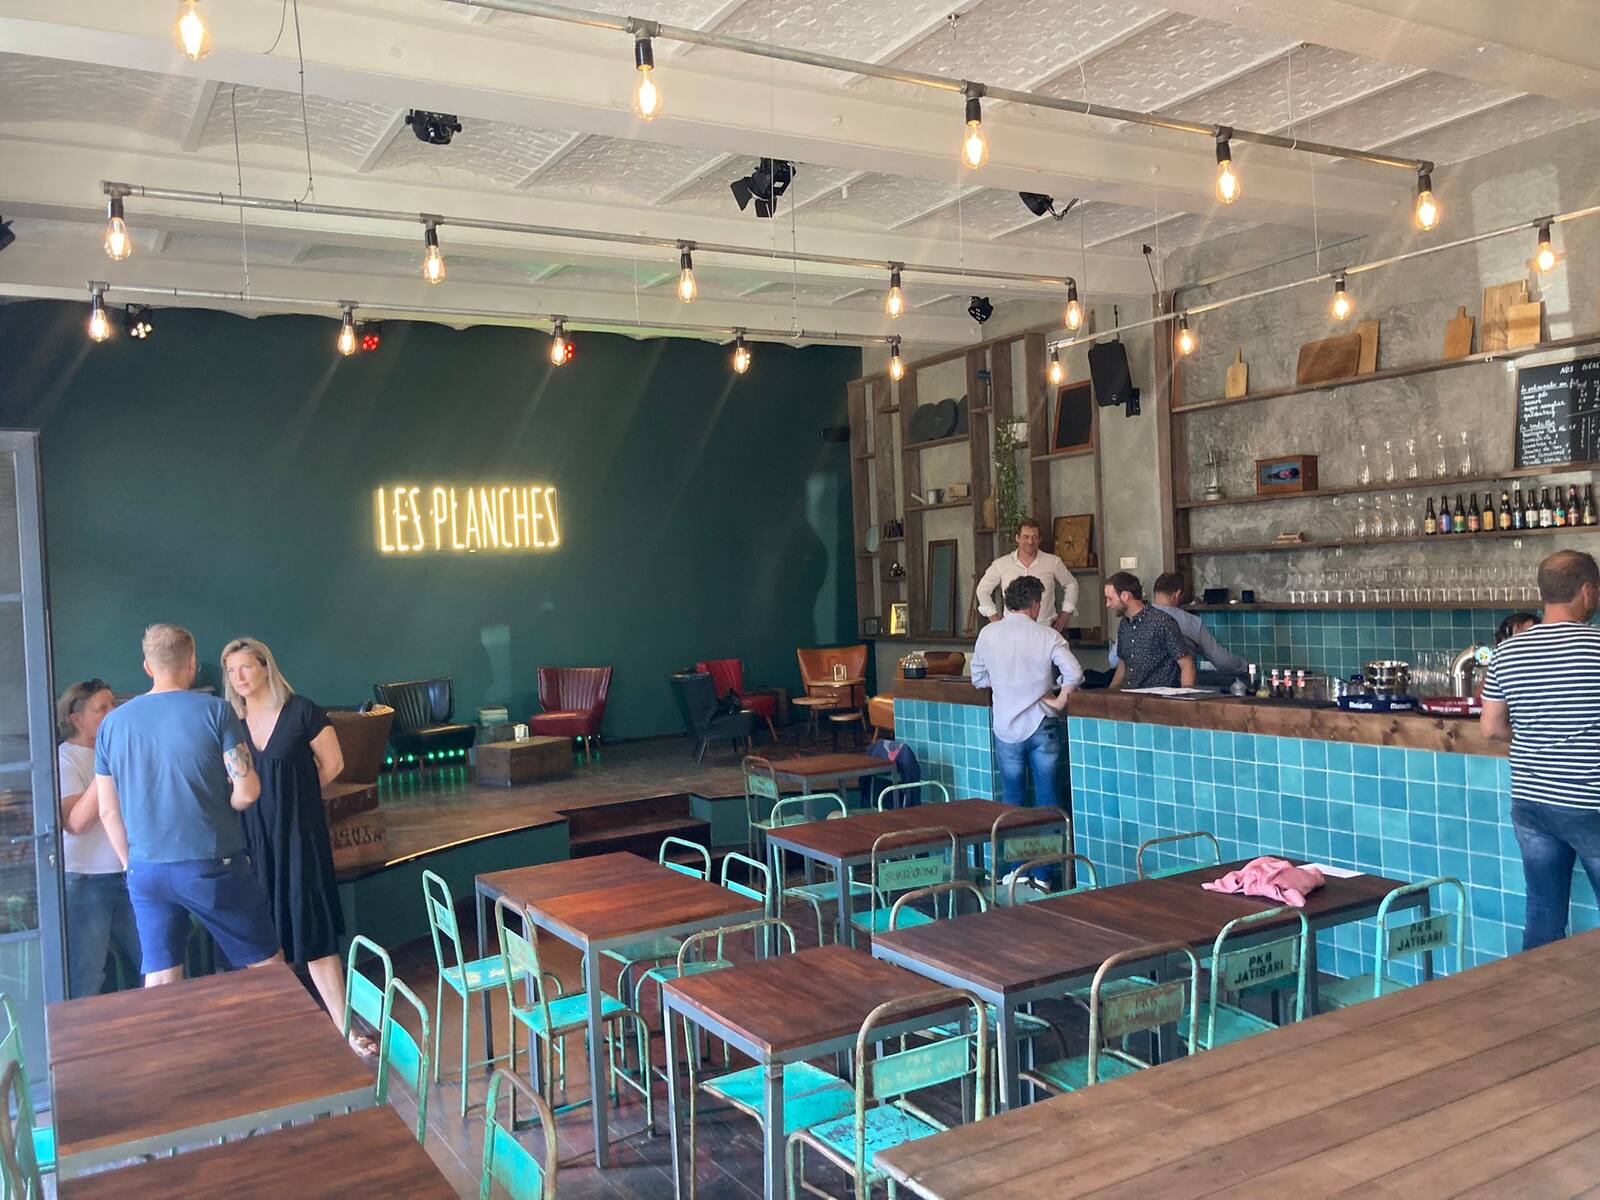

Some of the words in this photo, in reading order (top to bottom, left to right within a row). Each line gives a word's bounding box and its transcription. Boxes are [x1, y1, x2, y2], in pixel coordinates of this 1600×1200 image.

[378, 487, 424, 551] LES
[432, 487, 560, 550] PLANCHES
[1396, 931, 1443, 952] JATISARI
[1234, 960, 1284, 985] JATISARI
